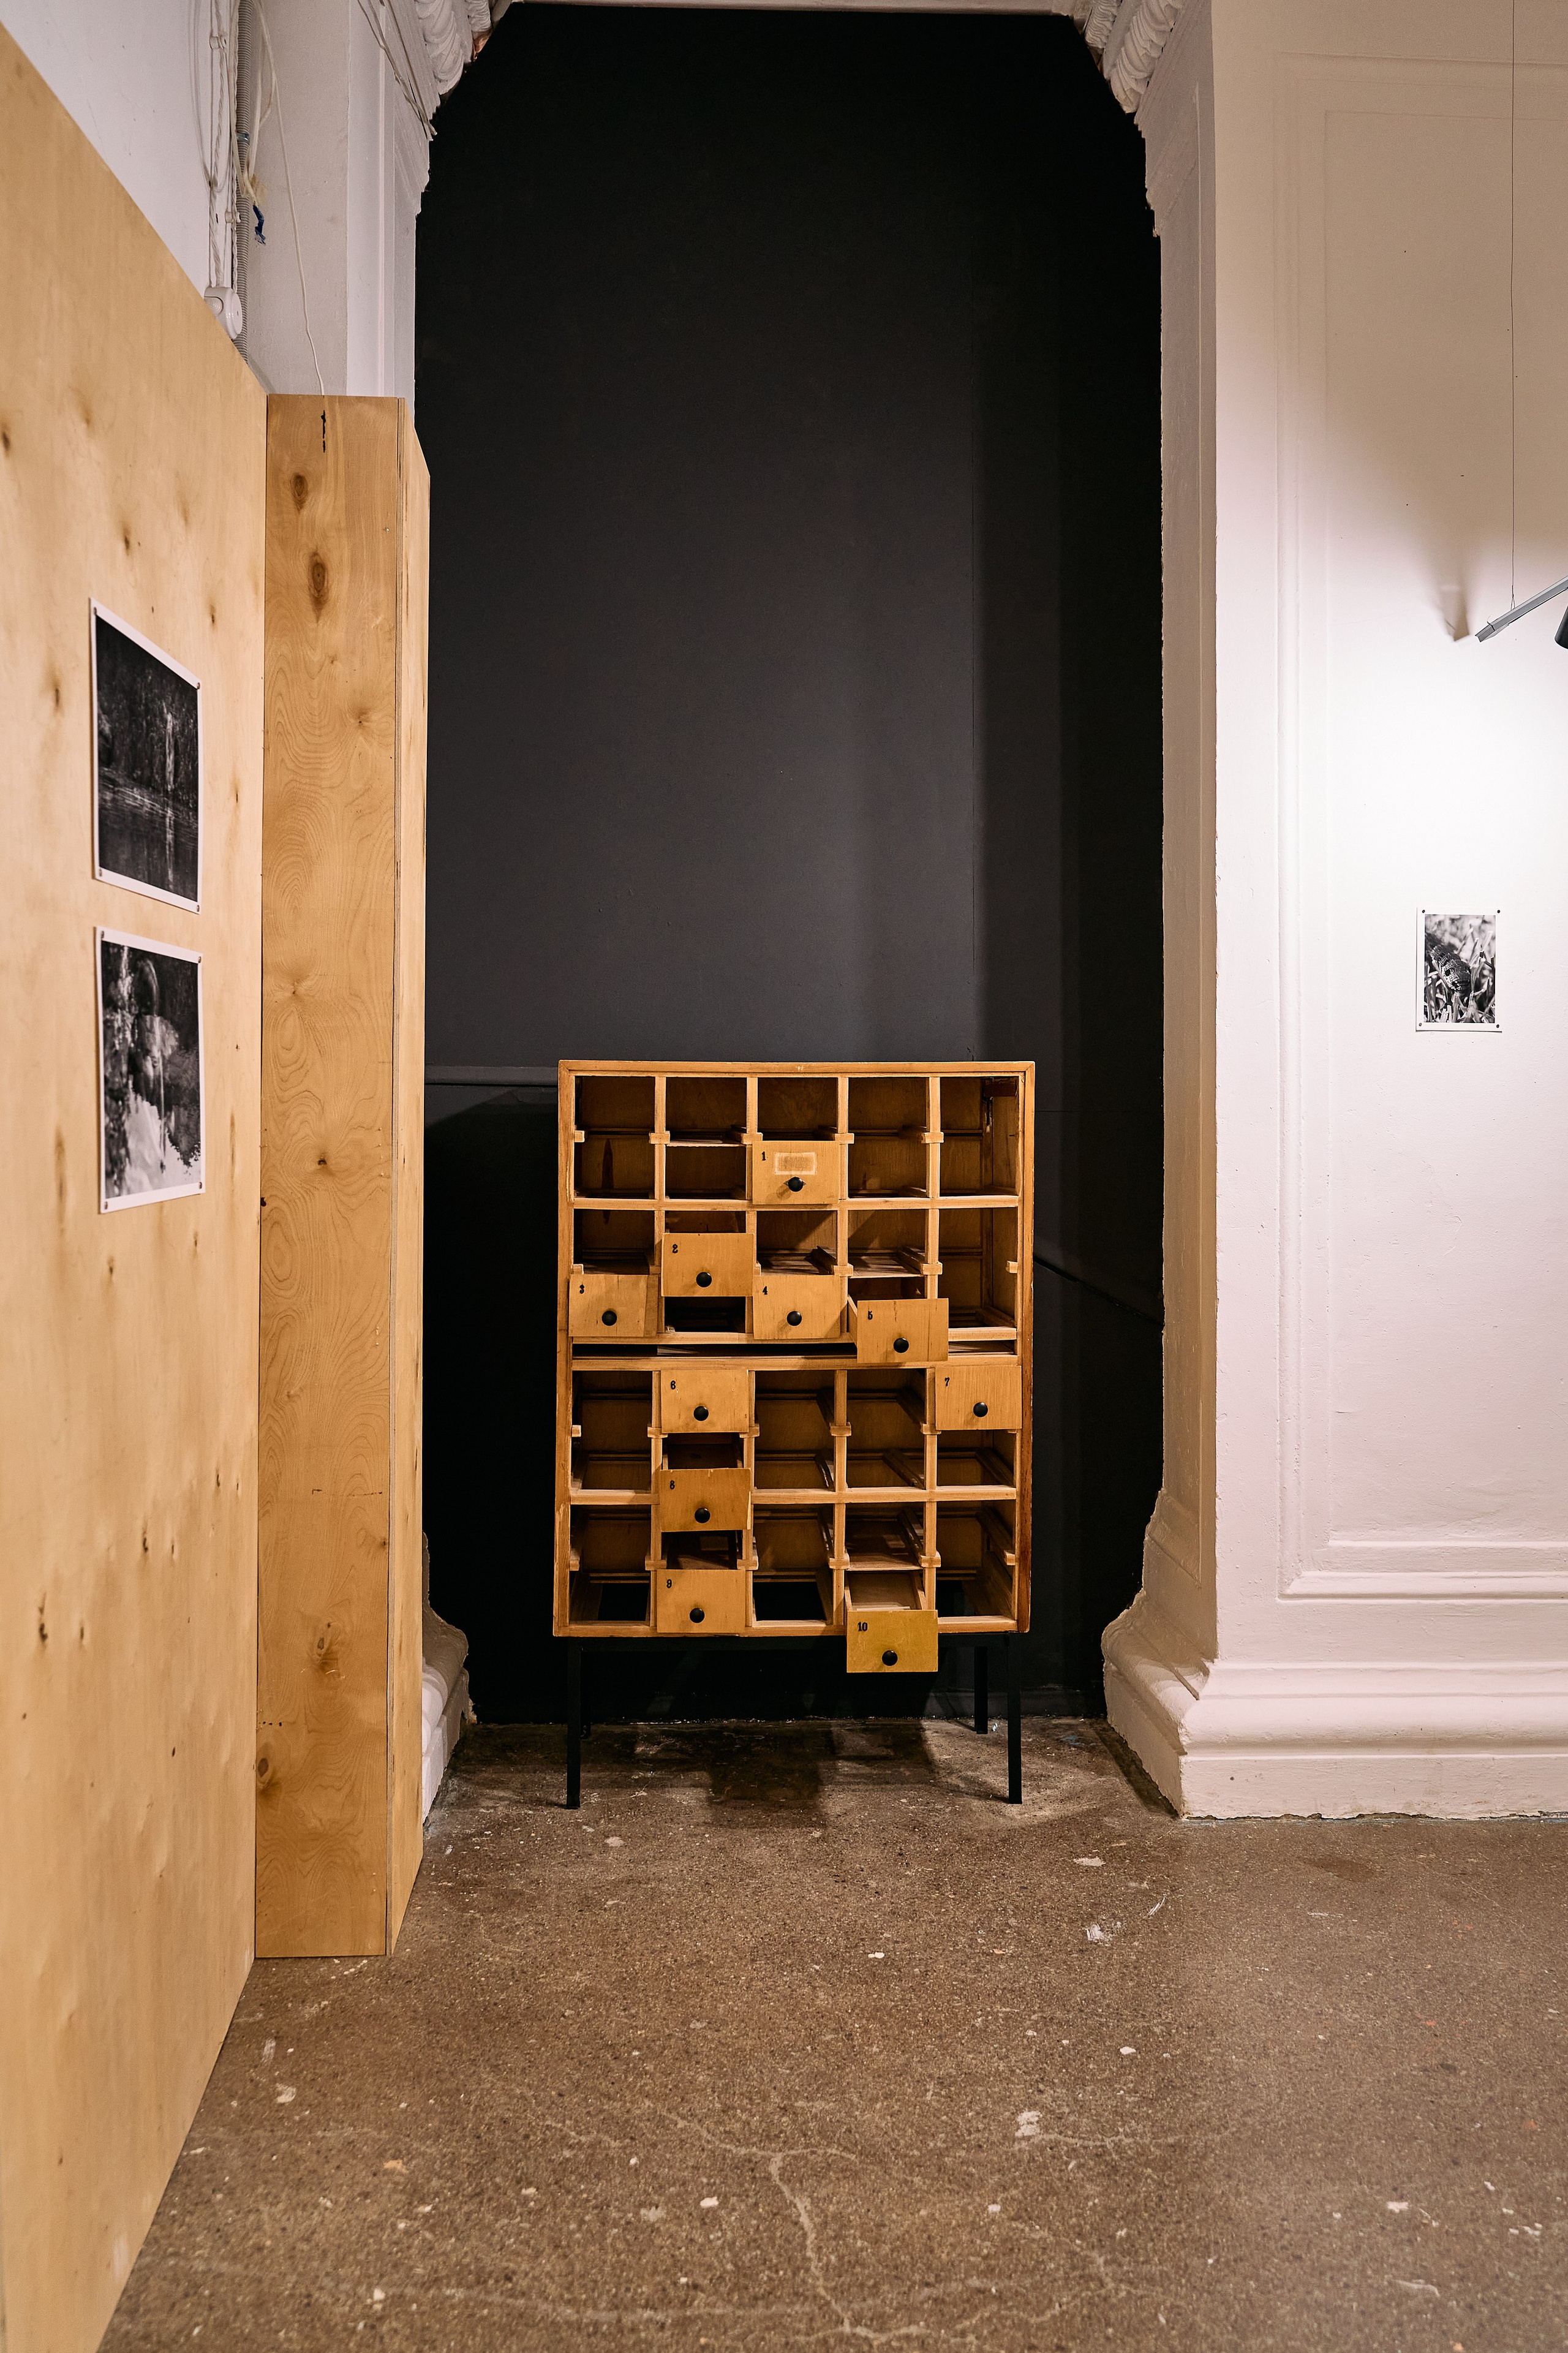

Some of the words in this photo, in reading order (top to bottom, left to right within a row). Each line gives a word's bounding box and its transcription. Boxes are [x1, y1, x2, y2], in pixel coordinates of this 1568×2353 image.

[761, 1151, 766, 1161] 1
[672, 1244, 679, 1254] 2
[579, 1283, 585, 1294] 3
[762, 1286, 768, 1296] 4
[867, 1310, 873, 1320] 5
[670, 1380, 676, 1390] 6
[944, 1377, 950, 1387] 7
[669, 1479, 676, 1490] 8
[666, 1579, 673, 1589] 9
[858, 1621, 868, 1632] 10
